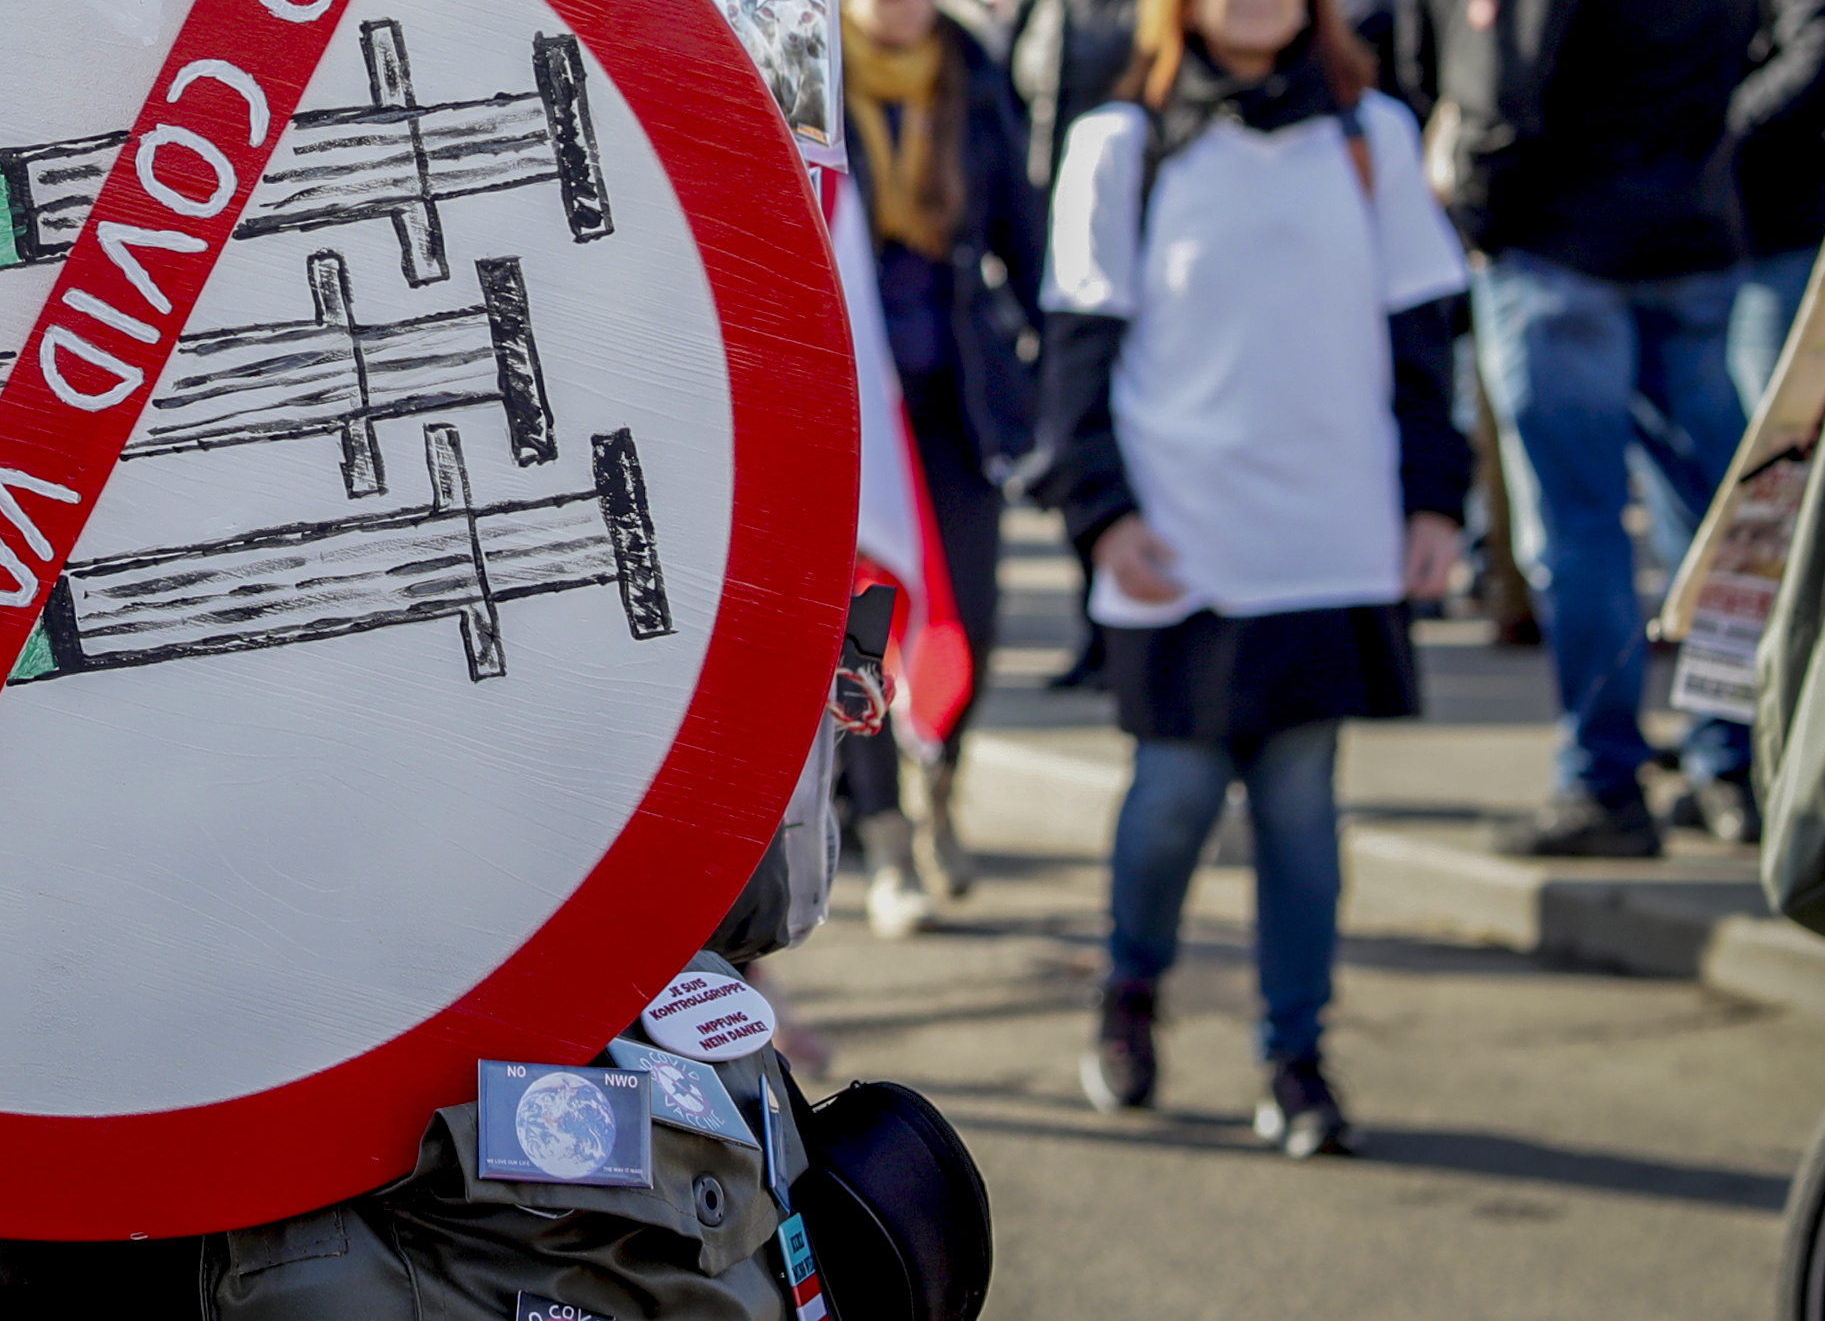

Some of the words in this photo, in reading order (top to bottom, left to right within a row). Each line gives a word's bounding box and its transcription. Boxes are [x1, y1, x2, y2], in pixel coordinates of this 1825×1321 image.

[39, 58, 271, 412] COVID
[668, 986, 684, 998] JE
[681, 978, 707, 993] SUIS
[648, 982, 746, 1021] KONTROLLGRUPPE
[696, 1011, 749, 1036] IMPFUNG
[699, 1033, 730, 1051] NEIN
[507, 1065, 526, 1078] NO
[604, 1073, 638, 1088] NWO
